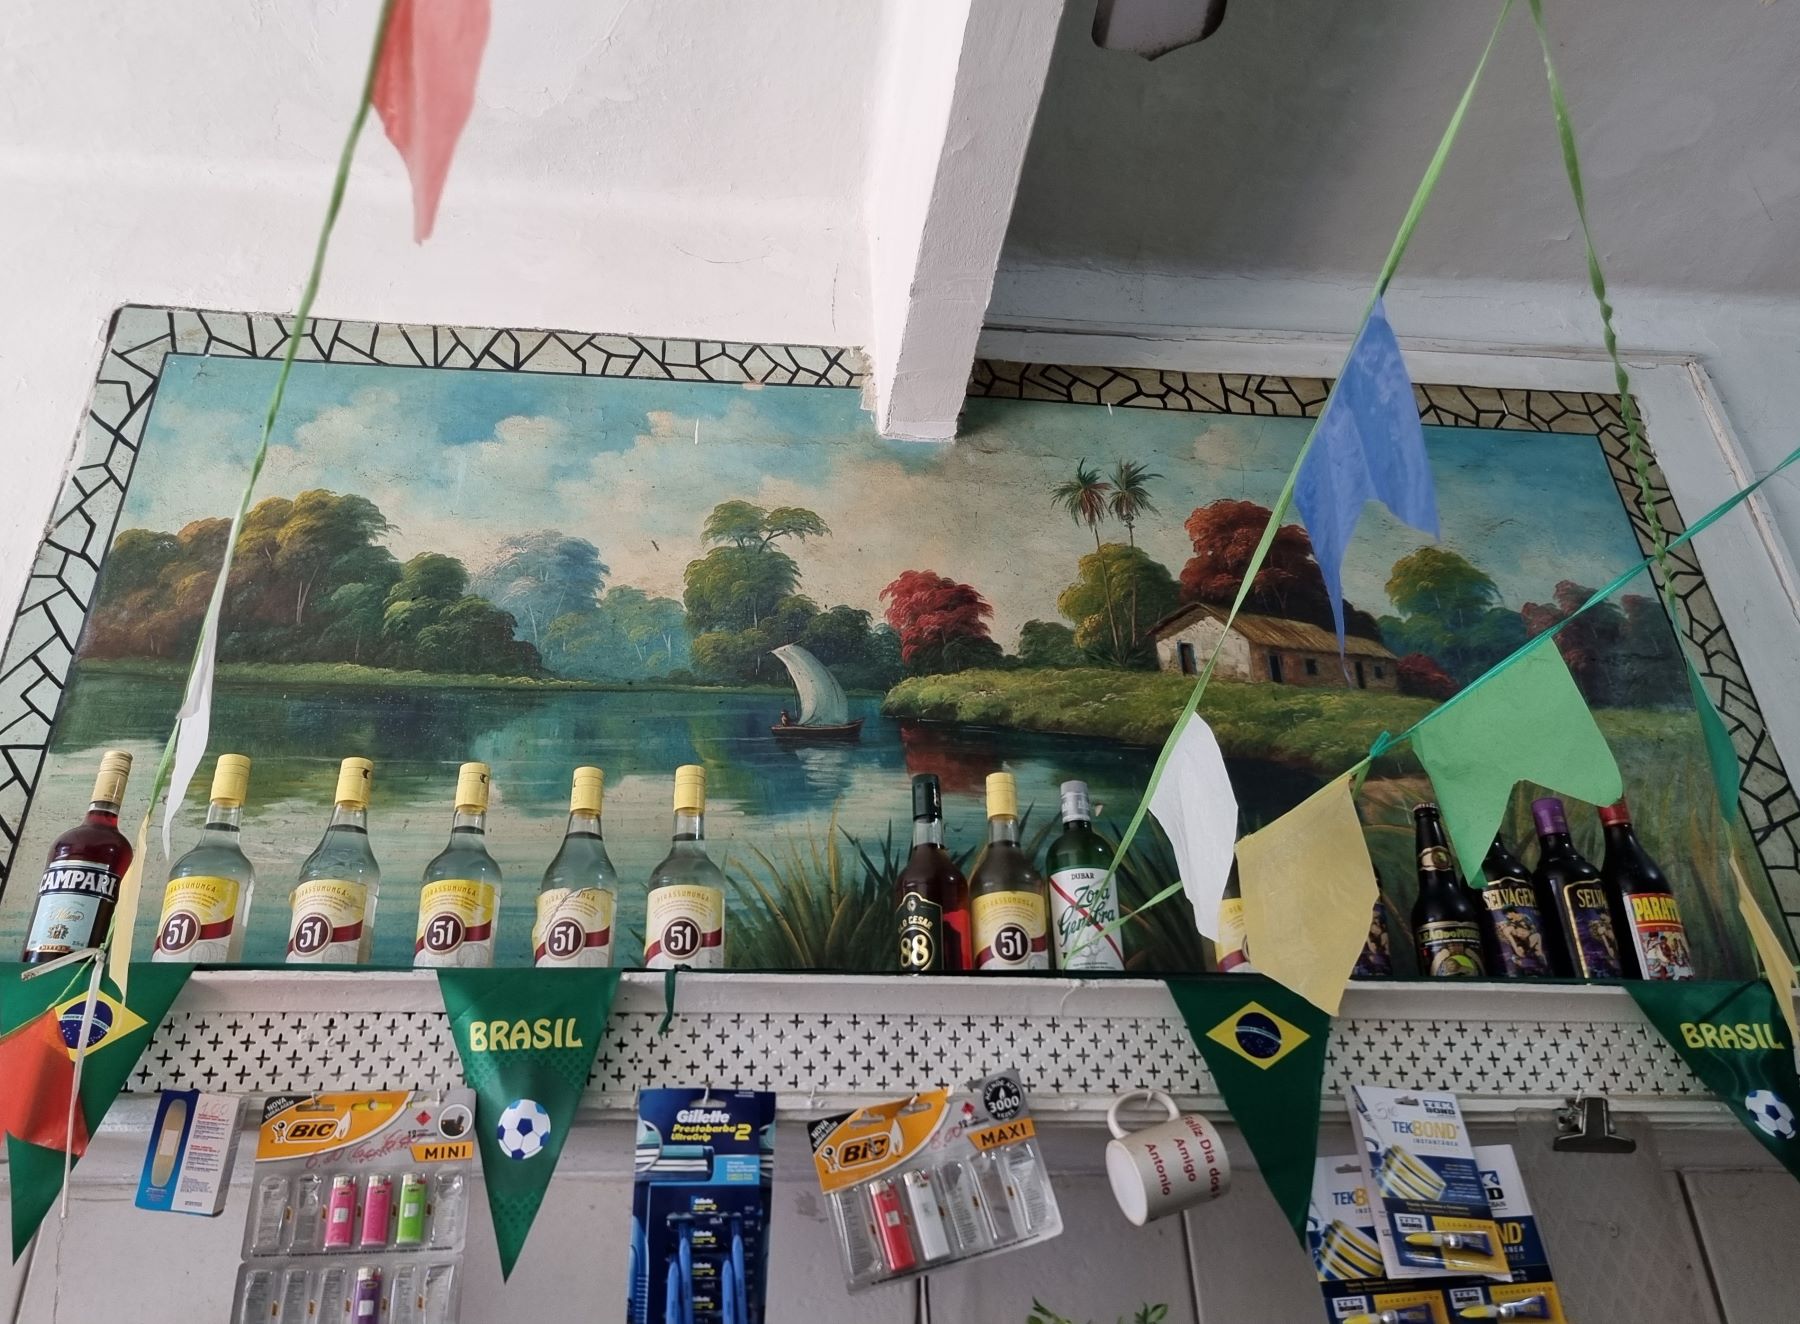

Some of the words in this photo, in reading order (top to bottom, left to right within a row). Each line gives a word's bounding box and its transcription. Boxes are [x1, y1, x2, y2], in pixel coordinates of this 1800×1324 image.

[39, 870, 117, 897] CAMPARI
[1071, 871, 1095, 880] DUBAR
[166, 918, 190, 946] 51
[299, 921, 322, 948] 51
[431, 920, 454, 946] 51
[553, 925, 575, 952] 51
[670, 925, 692, 951] 51
[1000, 931, 1023, 956] 51
[900, 934, 929, 968] 88
[470, 1018, 583, 1051] BRASIL
[1680, 1022, 1785, 1050] BRASIL
[267, 1097, 287, 1112] NOVA
[676, 1109, 731, 1124] Gillette
[988, 1096, 1020, 1114] 3000
[672, 1124, 736, 1134] Prestobarba
[734, 1123, 752, 1141] 2
[811, 1119, 831, 1139] NOVA
[980, 1122, 1027, 1147] MAXI
[1184, 1115, 1204, 1137] Feliz
[1200, 1139, 1216, 1164] Dia
[424, 1145, 466, 1160] MINI
[1173, 1138, 1197, 1182] Amigo
[1144, 1143, 1172, 1196] Antonio
[1332, 1187, 1368, 1207] TEKB
